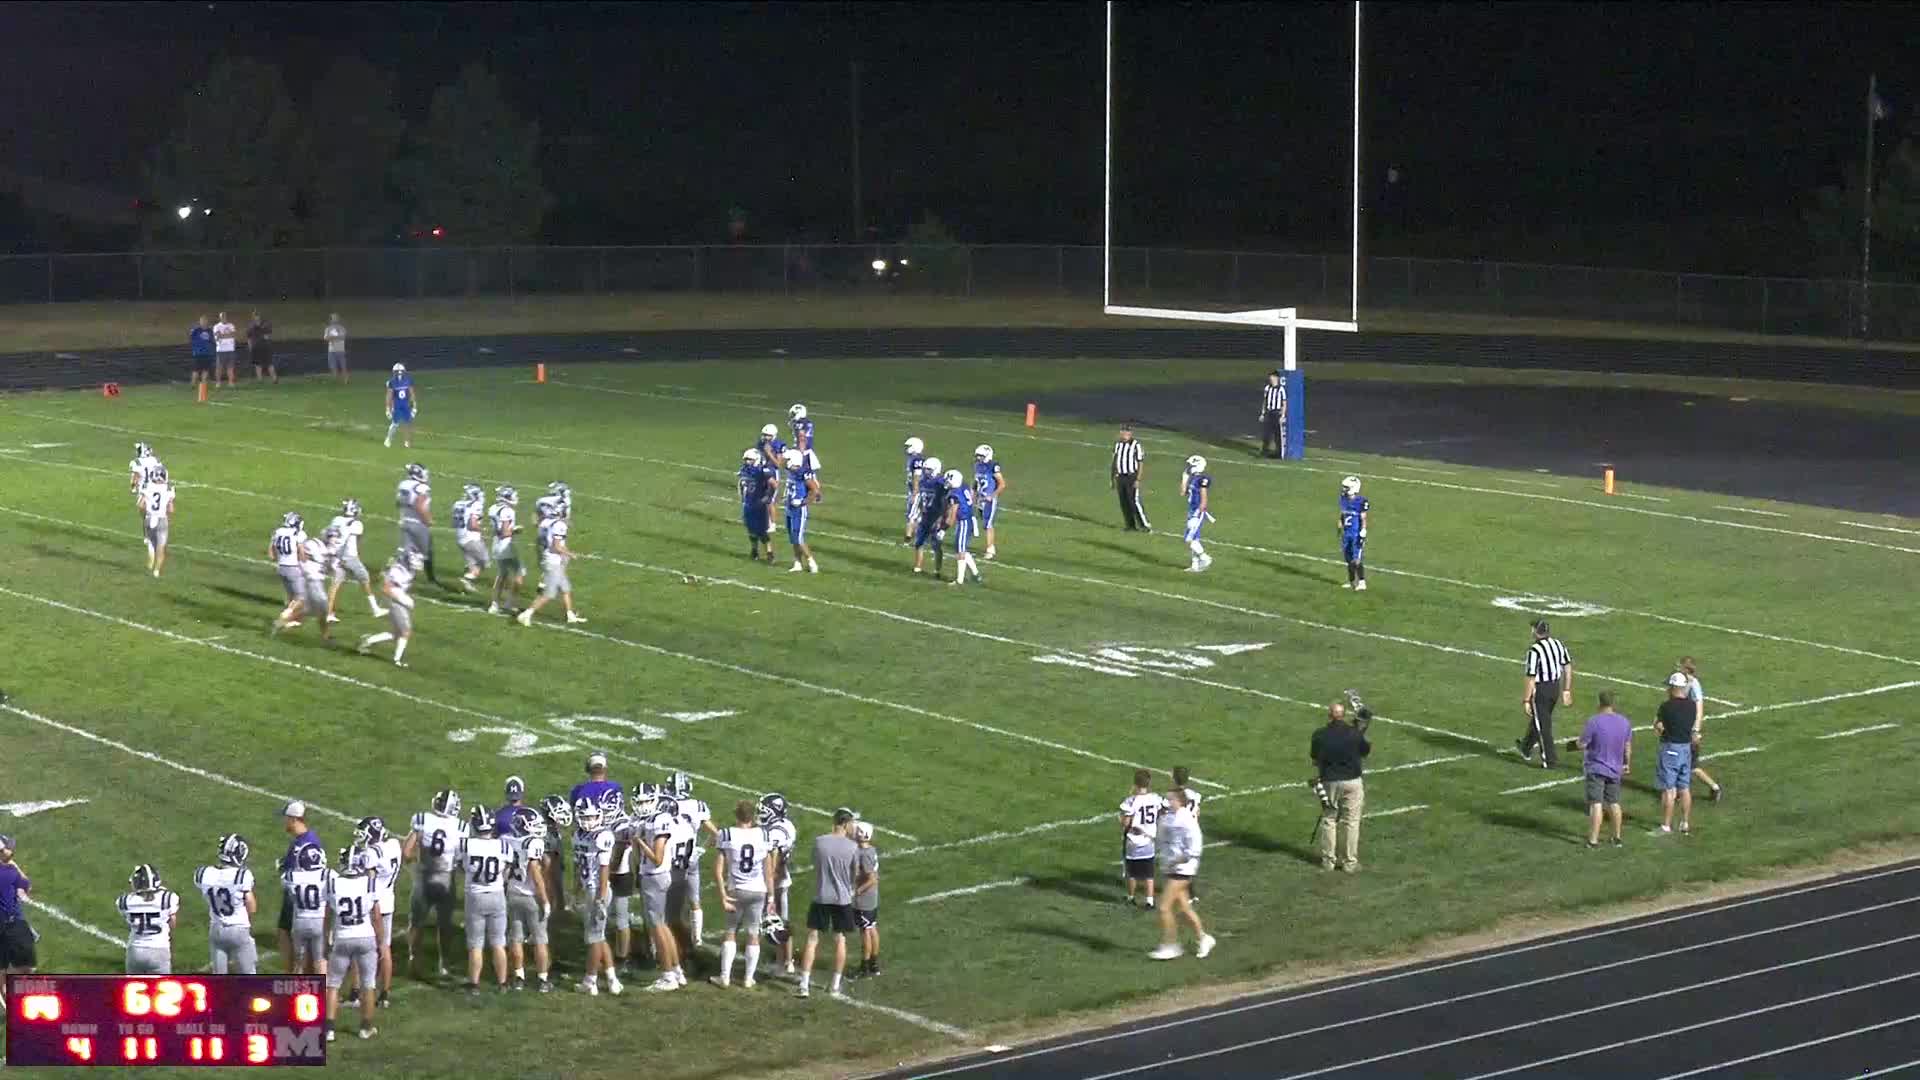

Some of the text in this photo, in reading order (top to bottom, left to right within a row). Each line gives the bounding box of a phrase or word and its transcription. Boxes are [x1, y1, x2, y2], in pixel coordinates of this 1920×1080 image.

[151, 492, 161, 511] 3
[276, 535, 292, 555] 40
[1138, 805, 1155, 825] 15
[432, 828, 447, 857] 6
[470, 855, 499, 883] 70
[739, 843, 755, 874] 8
[207, 887, 235, 917] 13
[295, 884, 320, 911] 10
[338, 895, 364, 927] 21
